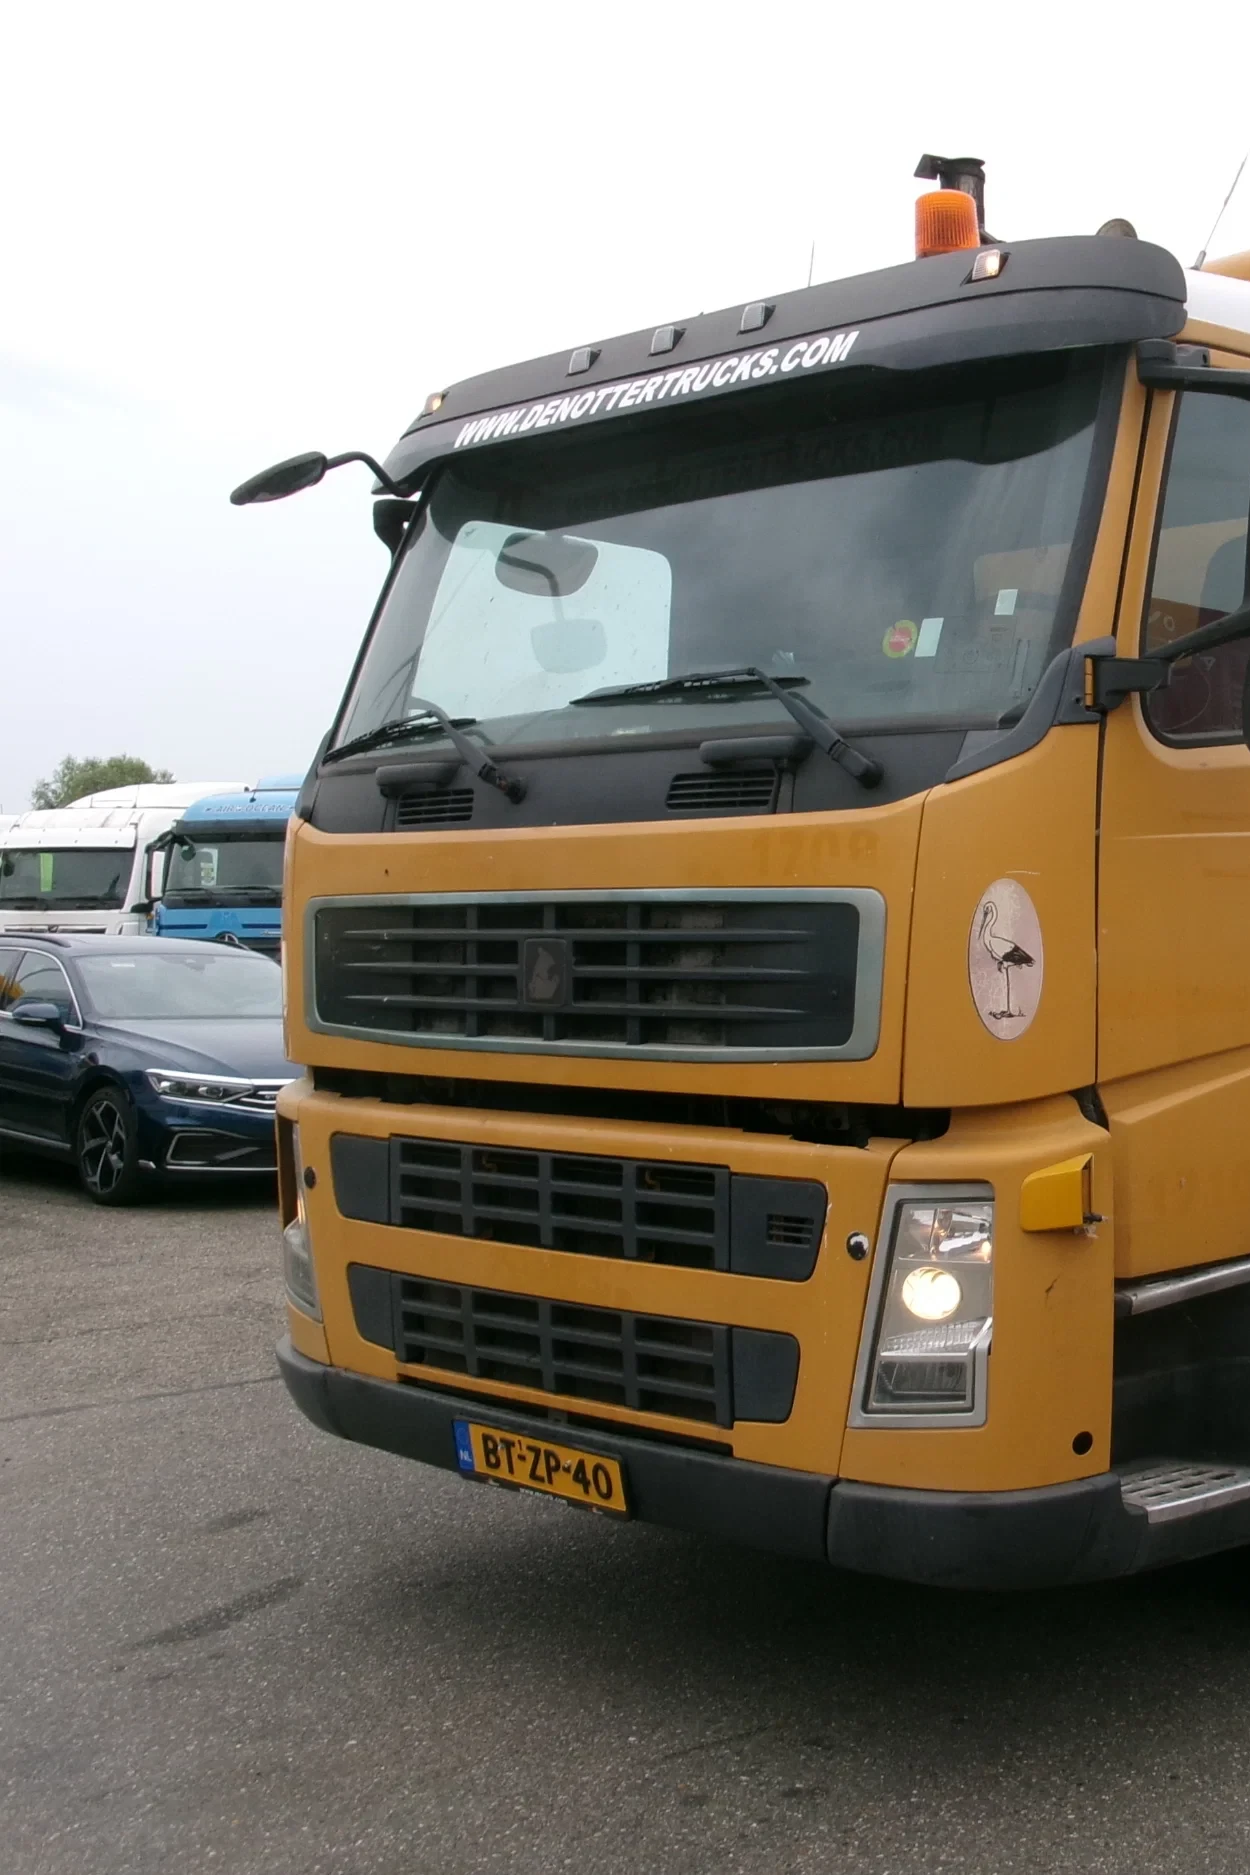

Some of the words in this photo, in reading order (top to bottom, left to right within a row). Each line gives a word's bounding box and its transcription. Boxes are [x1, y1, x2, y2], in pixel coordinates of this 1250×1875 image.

[453, 330, 861, 449] WWW.DENOTTERTRUCKS.COM
[459, 1449, 472, 1463] NL
[480, 1432, 614, 1500] BT-ZP-40
